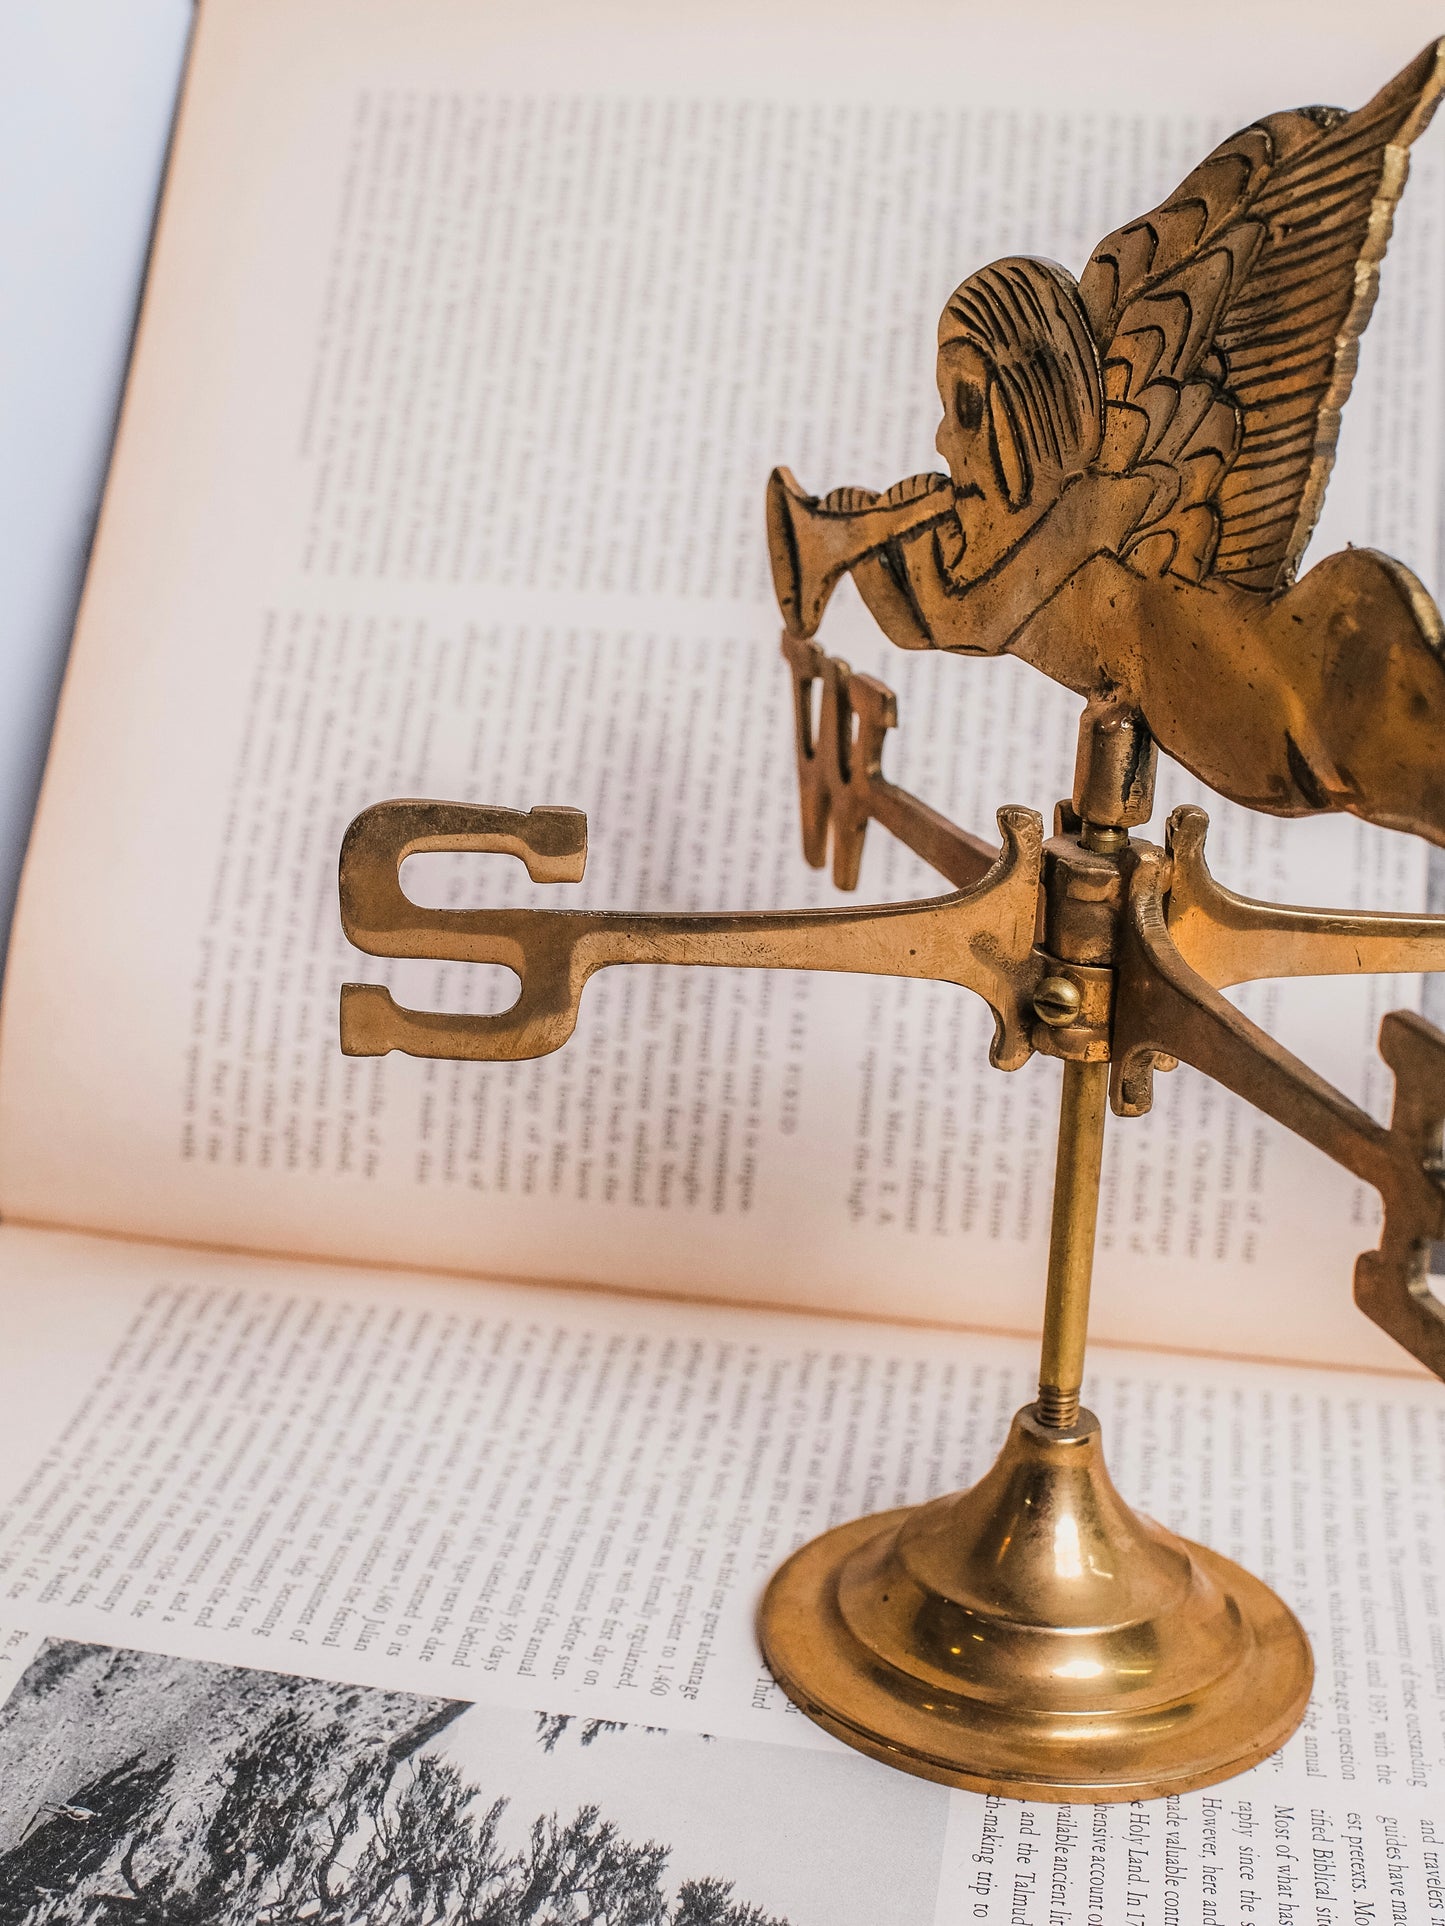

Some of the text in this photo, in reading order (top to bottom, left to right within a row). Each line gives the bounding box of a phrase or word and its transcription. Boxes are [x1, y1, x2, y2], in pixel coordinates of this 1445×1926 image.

[339, 799, 588, 1061] S
[130, 1600, 153, 1619] the
[169, 1592, 190, 1613] and
[207, 1587, 229, 1604] the
[237, 1596, 259, 1613] for
[253, 1582, 299, 1637] becoming
[440, 1585, 461, 1613] years
[608, 1597, 628, 1614] the
[195, 1606, 217, 1629] end
[223, 1616, 244, 1631] us,
[471, 1605, 493, 1625] fell
[539, 1602, 559, 1618] of
[666, 1584, 694, 1641] equivalent
[291, 1629, 308, 1645] of
[326, 1606, 357, 1648] festival
[353, 1615, 385, 1652] Julian
[398, 1624, 412, 1637] to
[431, 1616, 452, 1635] the
[498, 1622, 518, 1642] 365
[534, 1616, 558, 1635] the
[563, 1615, 591, 1652] before
[600, 1618, 622, 1641] first
[701, 1612, 720, 1640] great
[389, 1642, 408, 1656] its
[419, 1636, 444, 1663] date
[454, 1626, 485, 1668] behind
[484, 1645, 511, 1672] days
[519, 1636, 542, 1677] annual
[589, 1644, 614, 1665] day
[615, 1624, 648, 1689] regularized,
[663, 1645, 677, 1658] to
[554, 1654, 570, 1681] sun-
[586, 1670, 599, 1685] on
[650, 1664, 674, 1696] 1,460
[680, 1641, 712, 1701] advantage
[1333, 1670, 1353, 1690] the
[752, 1678, 777, 1710] Third
[1403, 1680, 1421, 1709] these
[1337, 1713, 1357, 1724] in
[1304, 1736, 1327, 1778] annual
[1332, 1727, 1361, 1780] question
[1373, 1732, 1395, 1757] with
[1406, 1714, 1432, 1787] outstanding
[1376, 1764, 1396, 1784] the
[1054, 1803, 1078, 1853] vailable
[1121, 1813, 1150, 1845] Holy
[1231, 1801, 1259, 1837] raphy
[1311, 1809, 1334, 1842] tified
[1420, 1819, 1444, 1844] and
[1376, 1816, 1407, 1860] guides
[1011, 1811, 1040, 1926] and the Talmud
[1127, 1848, 1149, 1886] Land.
[1165, 1832, 1187, 1886] valuable
[1198, 1797, 1224, 1926] However, here and
[1239, 1846, 1260, 1881] since
[1275, 1805, 1299, 1926] Most of what has
[1341, 1813, 1375, 1926] est pretexts. Mo
[970, 1872, 997, 1896] trip
[1050, 1856, 1072, 1906] ancient
[1088, 1856, 1109, 1909] account
[1312, 1849, 1337, 1901] Biblical
[1388, 1864, 1409, 1896] have
[1423, 1852, 1445, 1909] travelers
[973, 1904, 989, 1918] to
[1126, 1891, 1148, 1906] In
[1240, 1890, 1261, 1912] the
